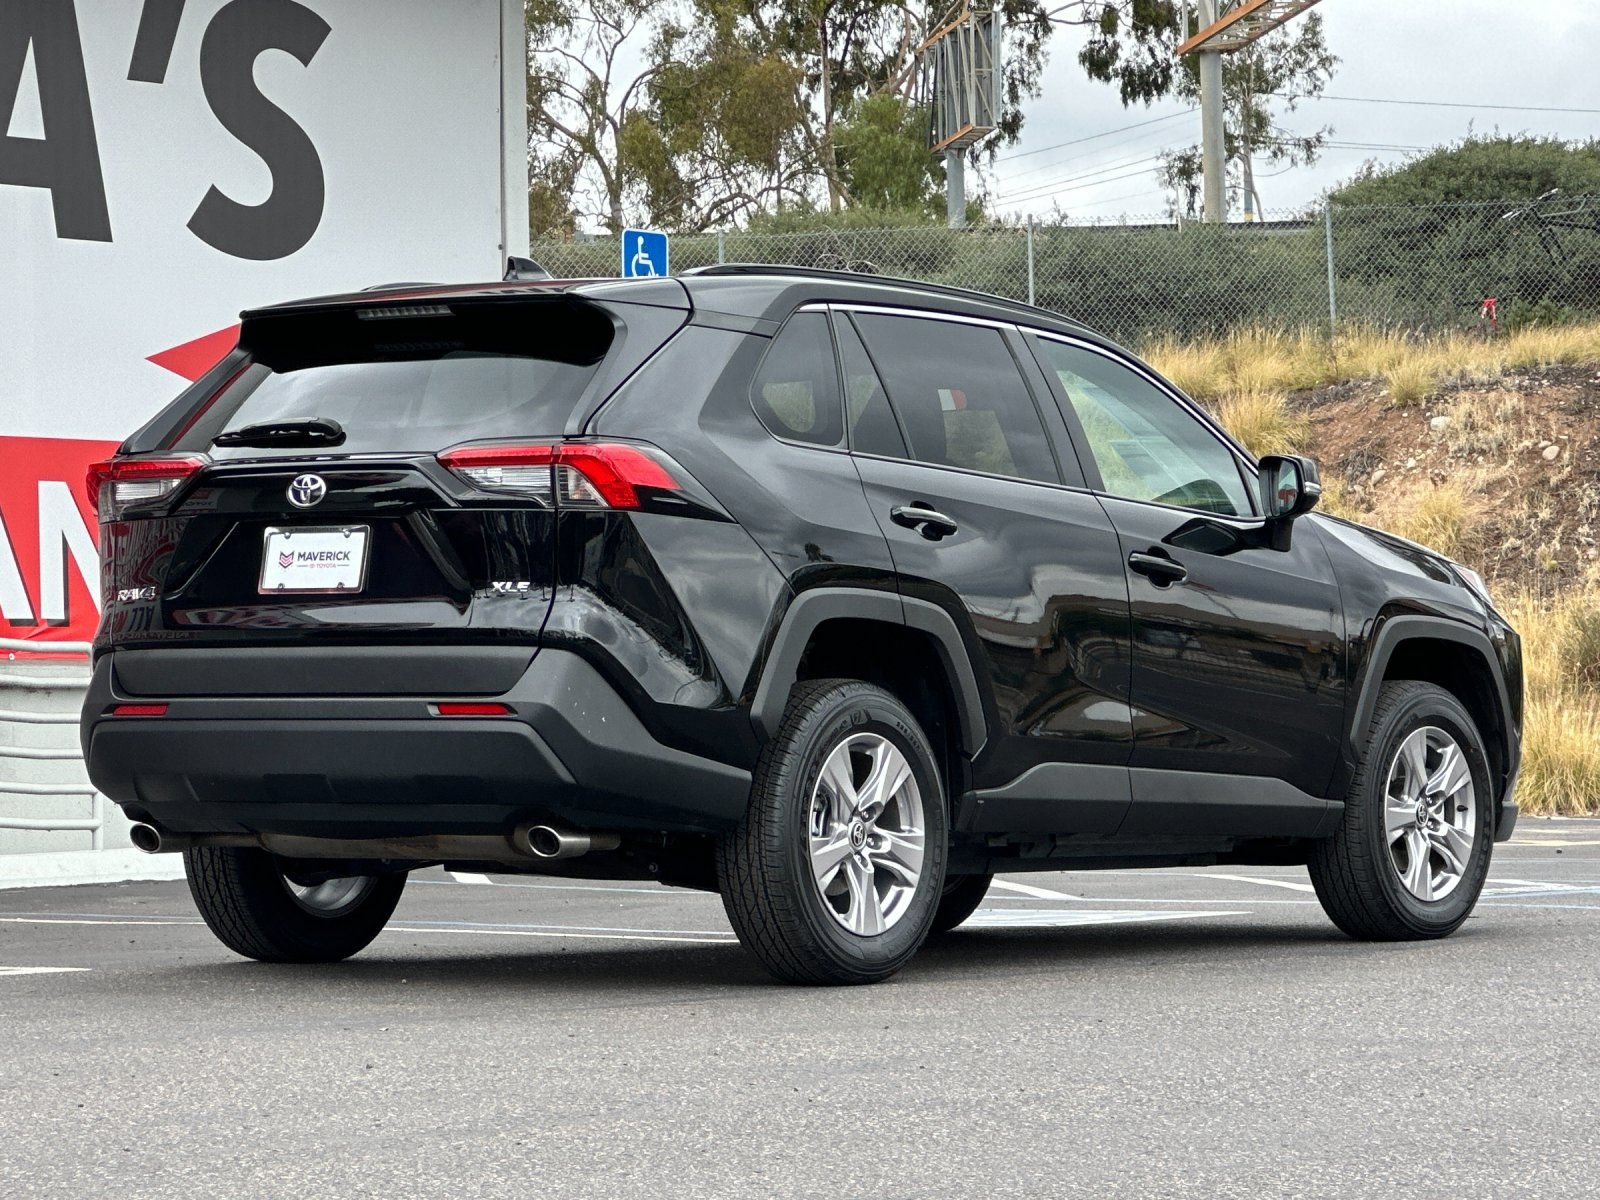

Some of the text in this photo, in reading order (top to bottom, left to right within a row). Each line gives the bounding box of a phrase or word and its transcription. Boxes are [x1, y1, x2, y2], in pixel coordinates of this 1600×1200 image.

[297, 551, 351, 561] MAVERICK
[491, 581, 530, 592] XLE
[117, 586, 156, 601] RAV4
